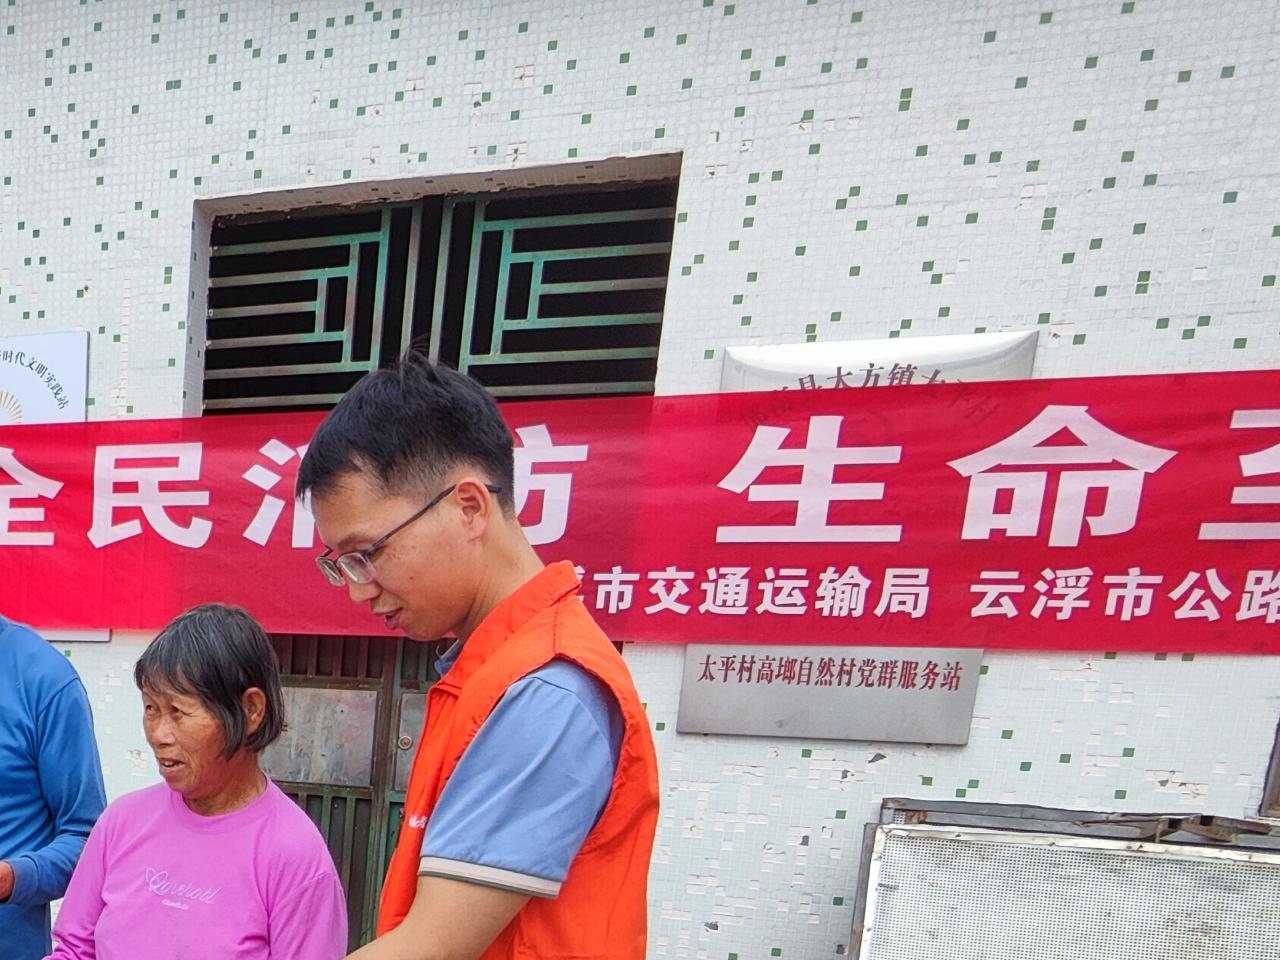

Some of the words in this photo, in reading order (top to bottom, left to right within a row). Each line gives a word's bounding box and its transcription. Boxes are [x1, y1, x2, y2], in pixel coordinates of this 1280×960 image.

[570, 565, 930, 618] 市交通运输局
